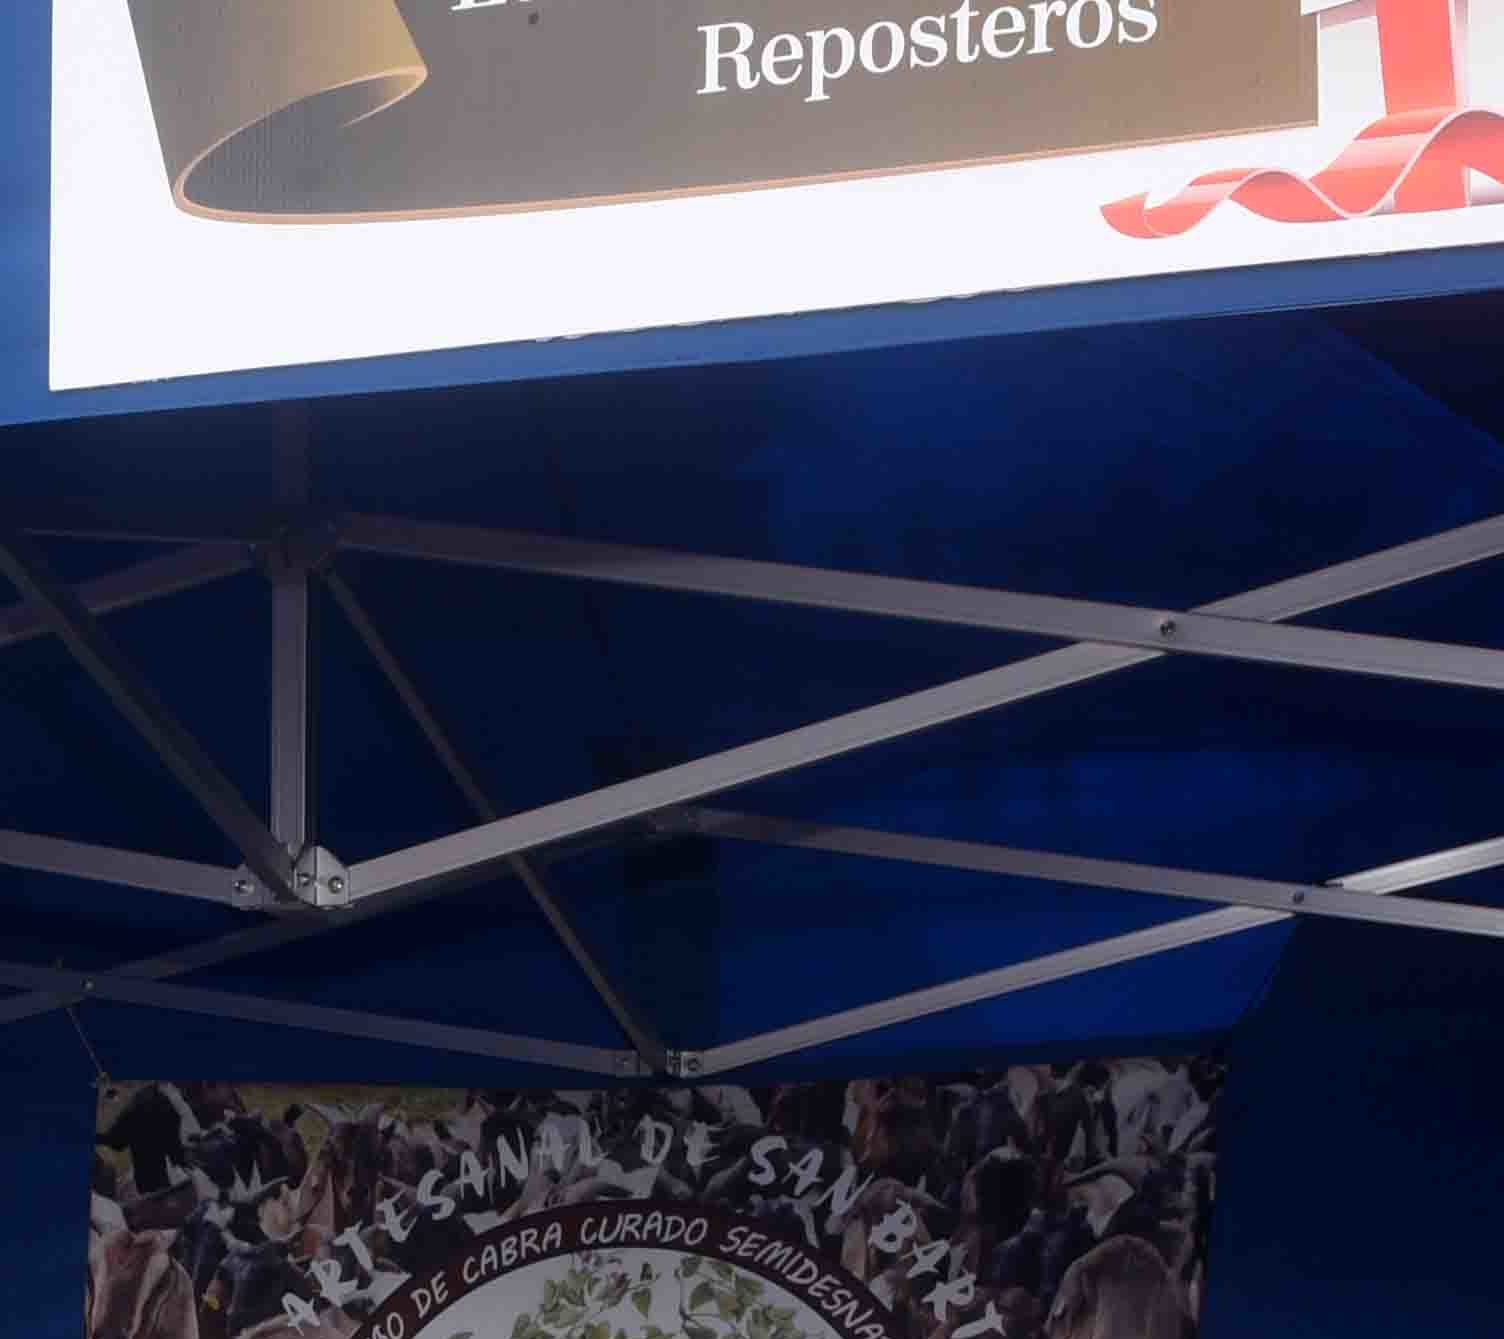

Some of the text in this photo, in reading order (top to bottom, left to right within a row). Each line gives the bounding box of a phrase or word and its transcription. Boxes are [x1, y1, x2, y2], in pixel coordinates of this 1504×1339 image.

[695, 0, 1160, 103] Reposteros
[635, 1115, 724, 1167] DE
[748, 1135, 873, 1217] SAN
[411, 1271, 449, 1320] DE
[463, 1222, 563, 1282] CABRA
[581, 1213, 709, 1245] CURADO
